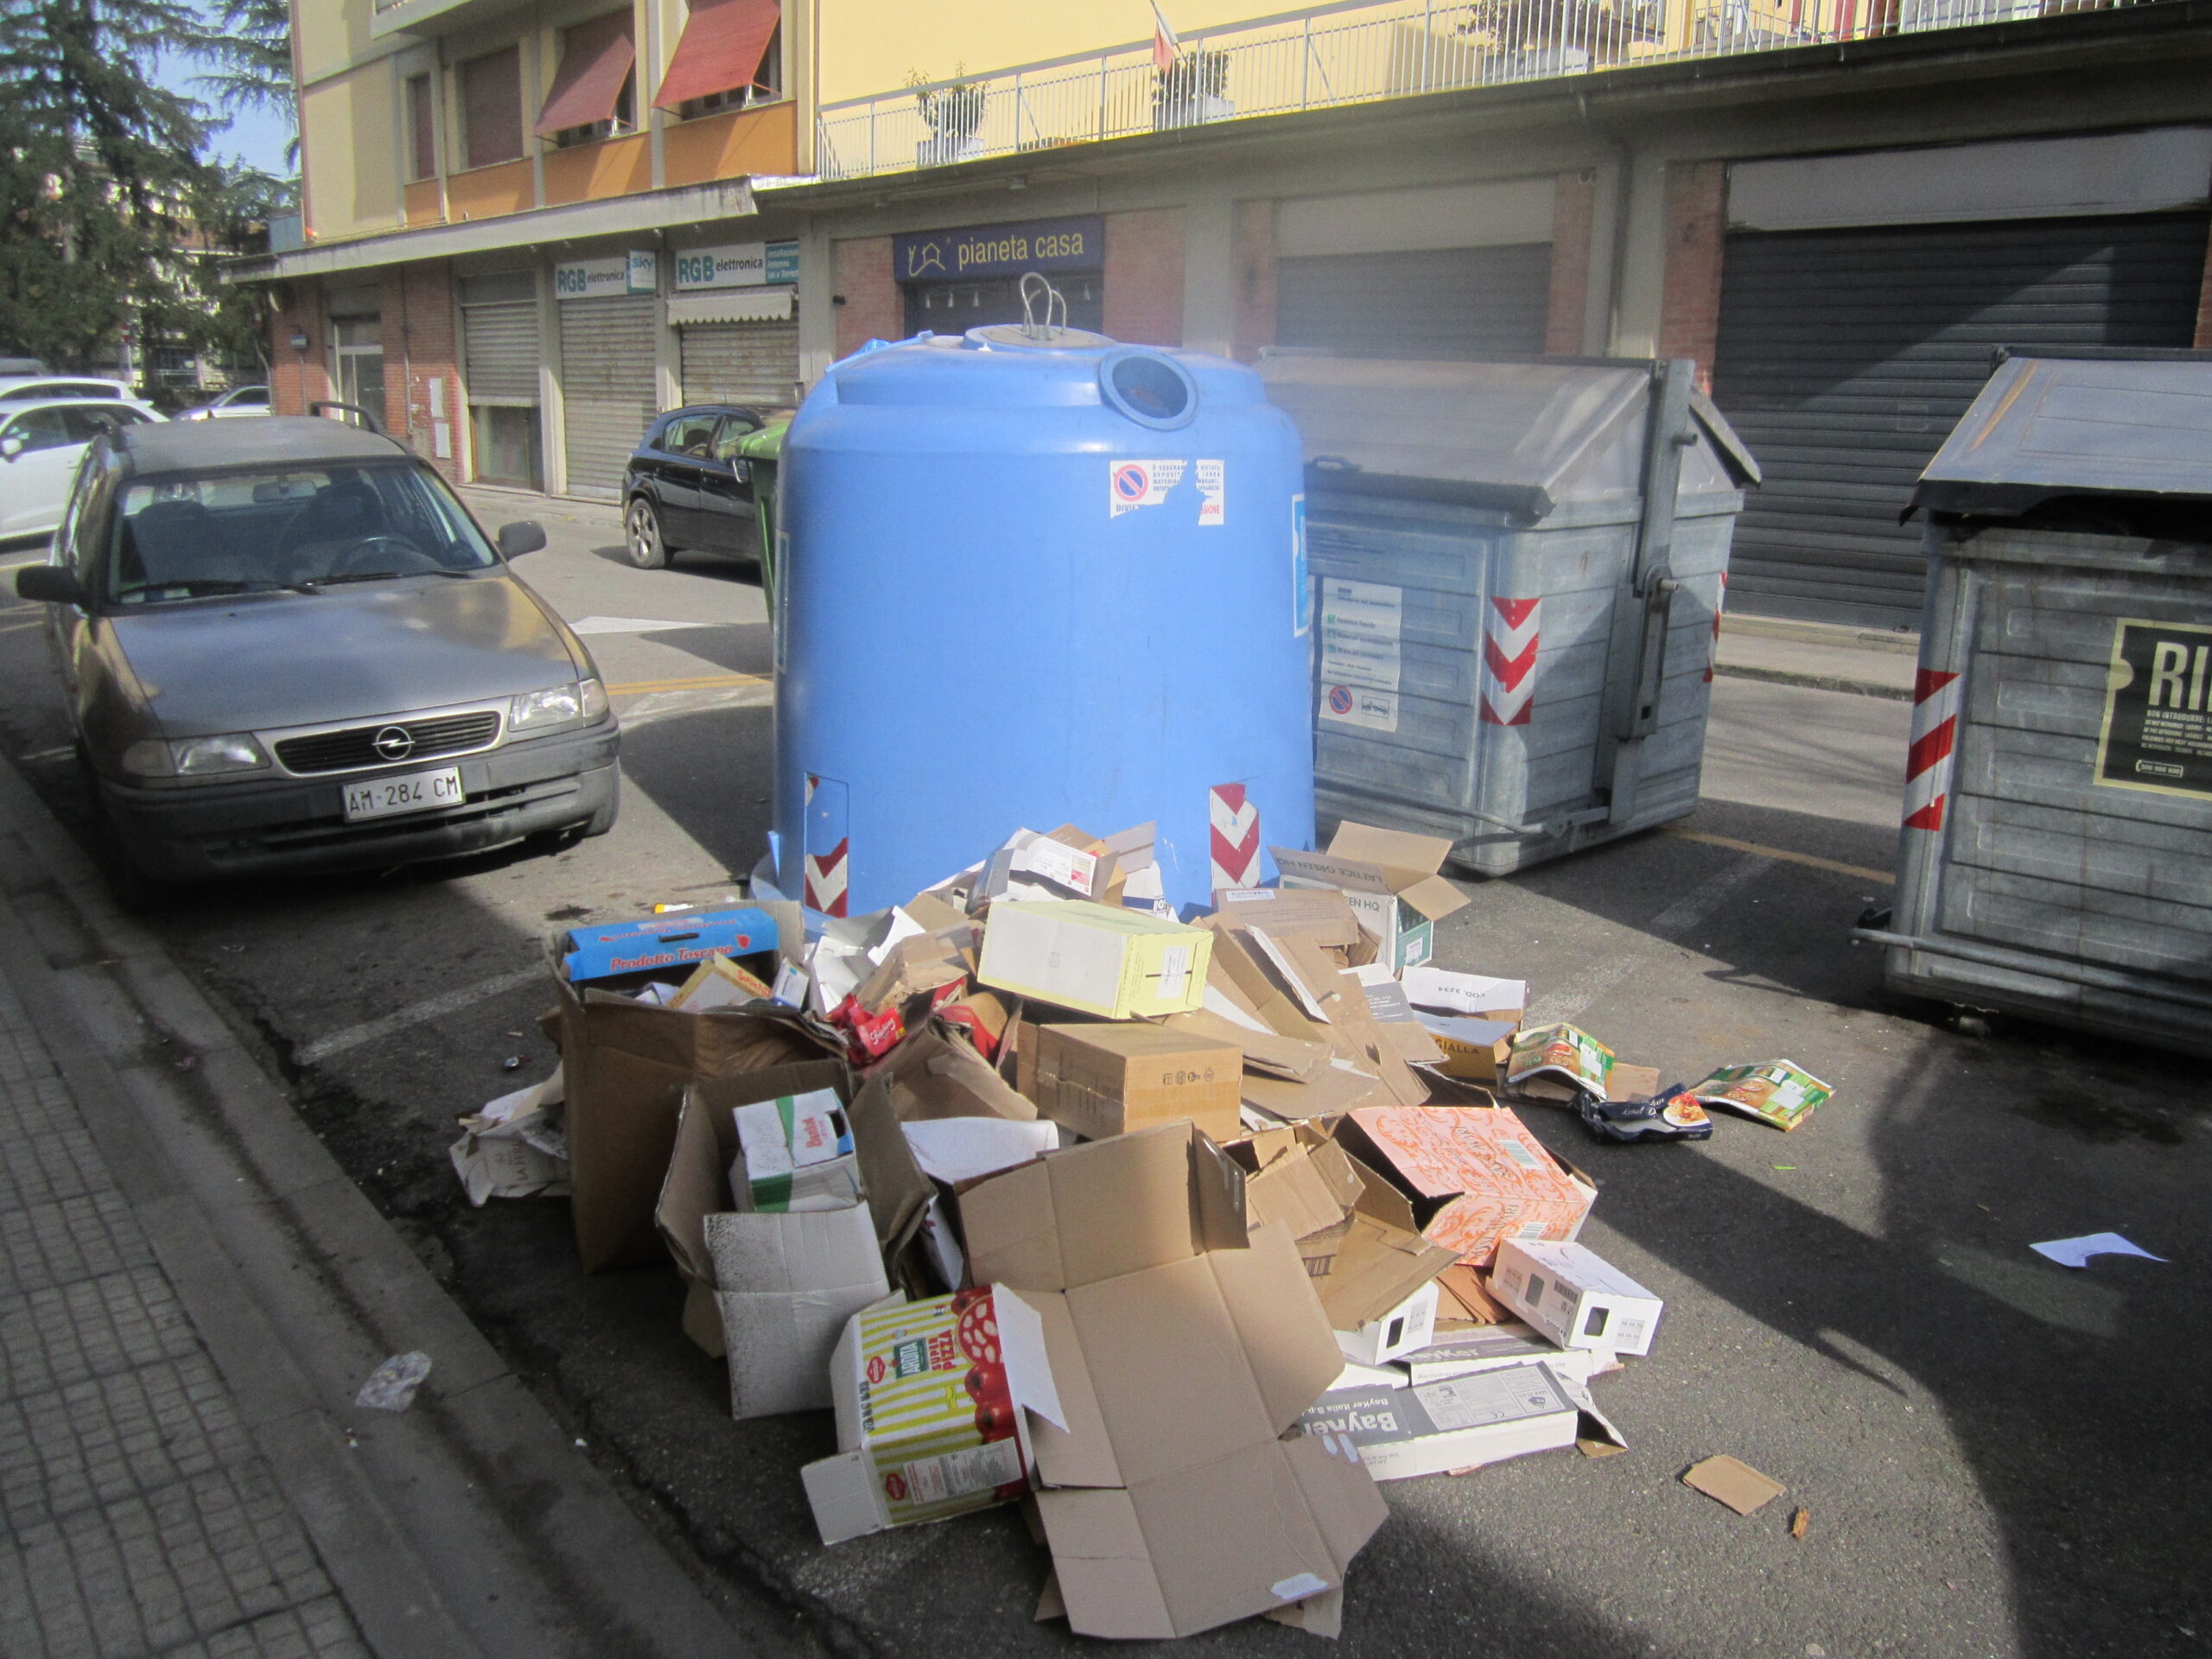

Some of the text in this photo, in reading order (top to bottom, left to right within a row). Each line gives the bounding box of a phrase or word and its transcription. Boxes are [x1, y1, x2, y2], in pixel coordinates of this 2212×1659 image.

[632, 255, 653, 270] sky
[957, 232, 1084, 270] pianeta casa
[557, 269, 625, 293] RGB elettronica
[677, 255, 764, 283] RGB elettronica
[2148, 641, 2212, 713] RI
[349, 775, 459, 812] AM 284 CM
[1298, 861, 1336, 874] GREEN
[1338, 868, 1382, 883] LATTICE
[1363, 899, 1380, 912] HQ
[610, 945, 734, 972] Prodotto Toscano
[1438, 986, 1486, 999] COD. 3234
[900, 1341, 921, 1376] ARDITA
[928, 1335, 943, 1371] SUPER
[938, 1329, 959, 1372] PIZZA
[1326, 1402, 1351, 1414] Italia
[1351, 1397, 1389, 1408] BayKer
